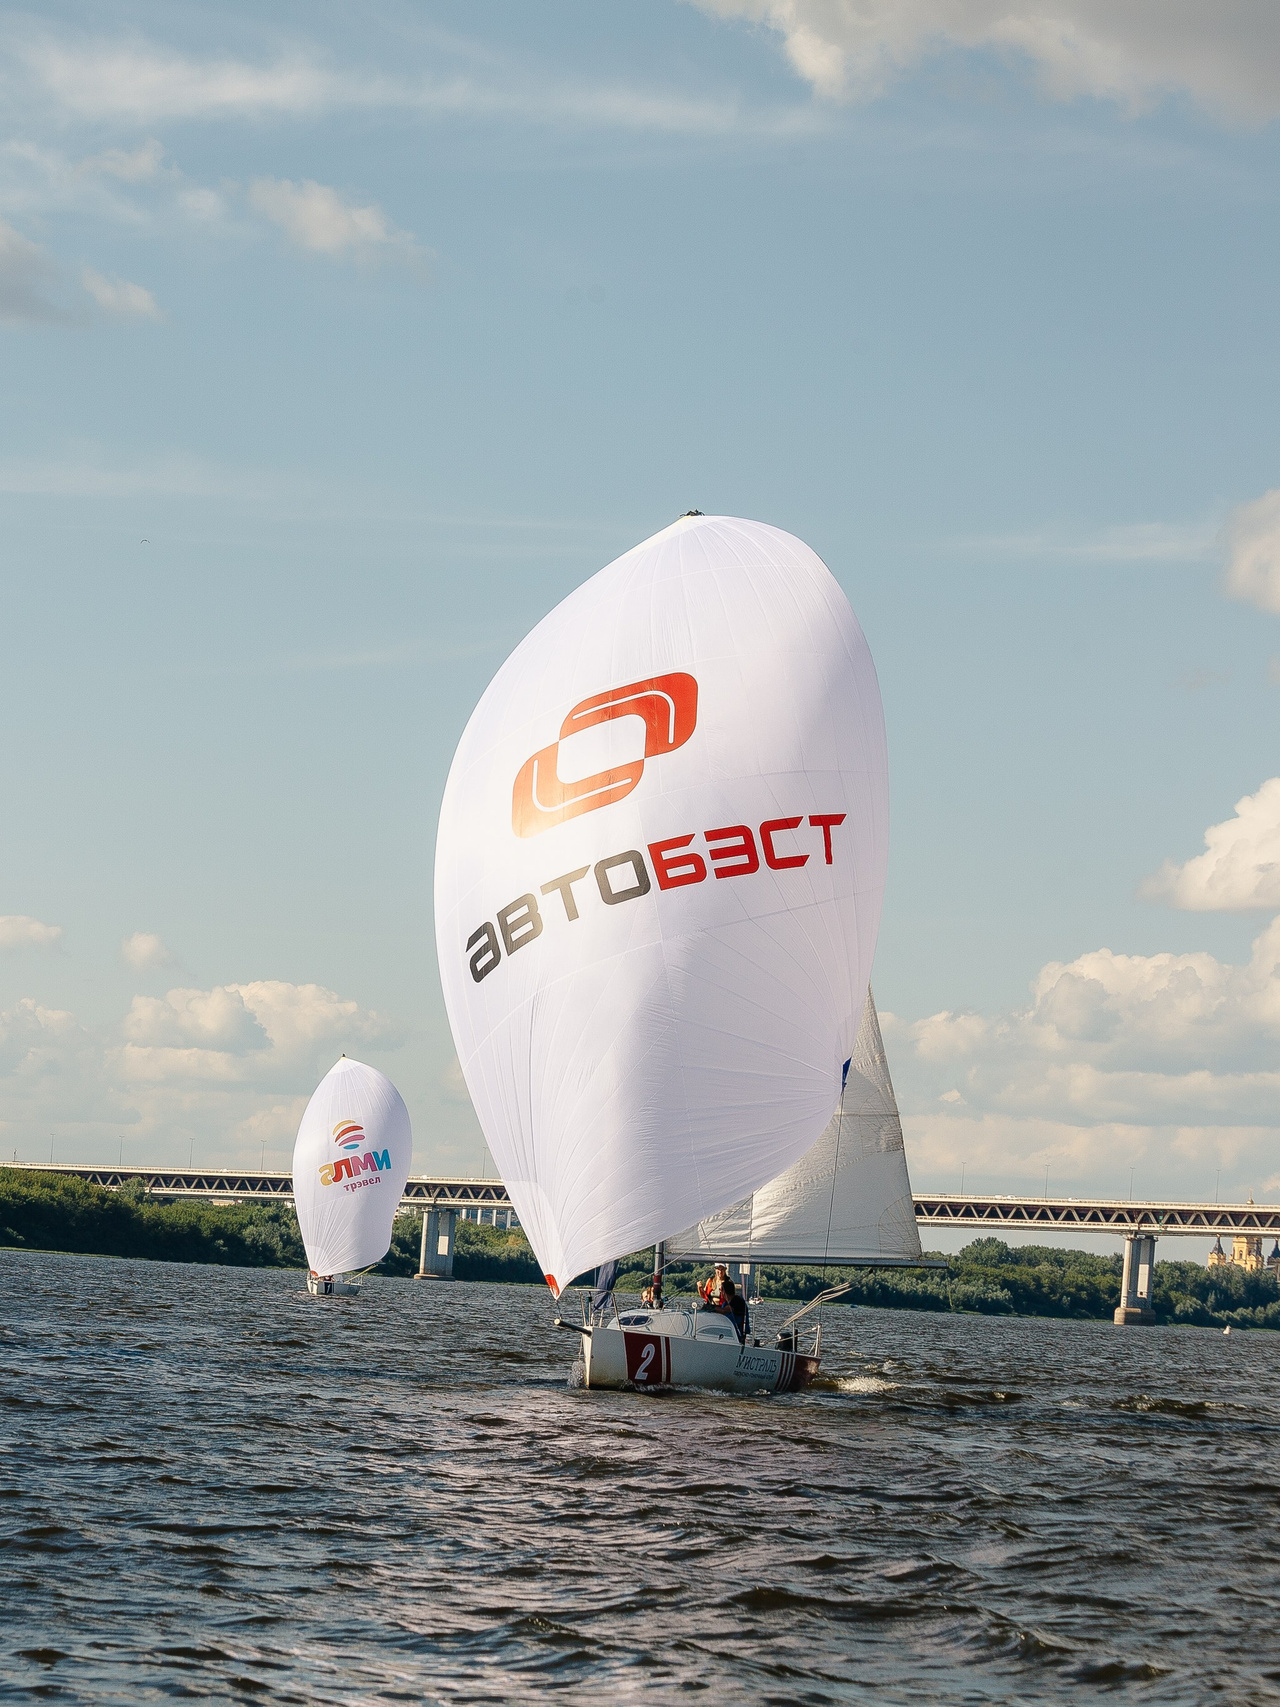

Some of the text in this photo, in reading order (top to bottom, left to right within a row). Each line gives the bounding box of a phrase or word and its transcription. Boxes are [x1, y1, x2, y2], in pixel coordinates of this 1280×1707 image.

[343, 1176, 382, 1193] трэвел
[634, 1343, 656, 1380] 2
[735, 1355, 778, 1373] МИСТРАЛЬ
